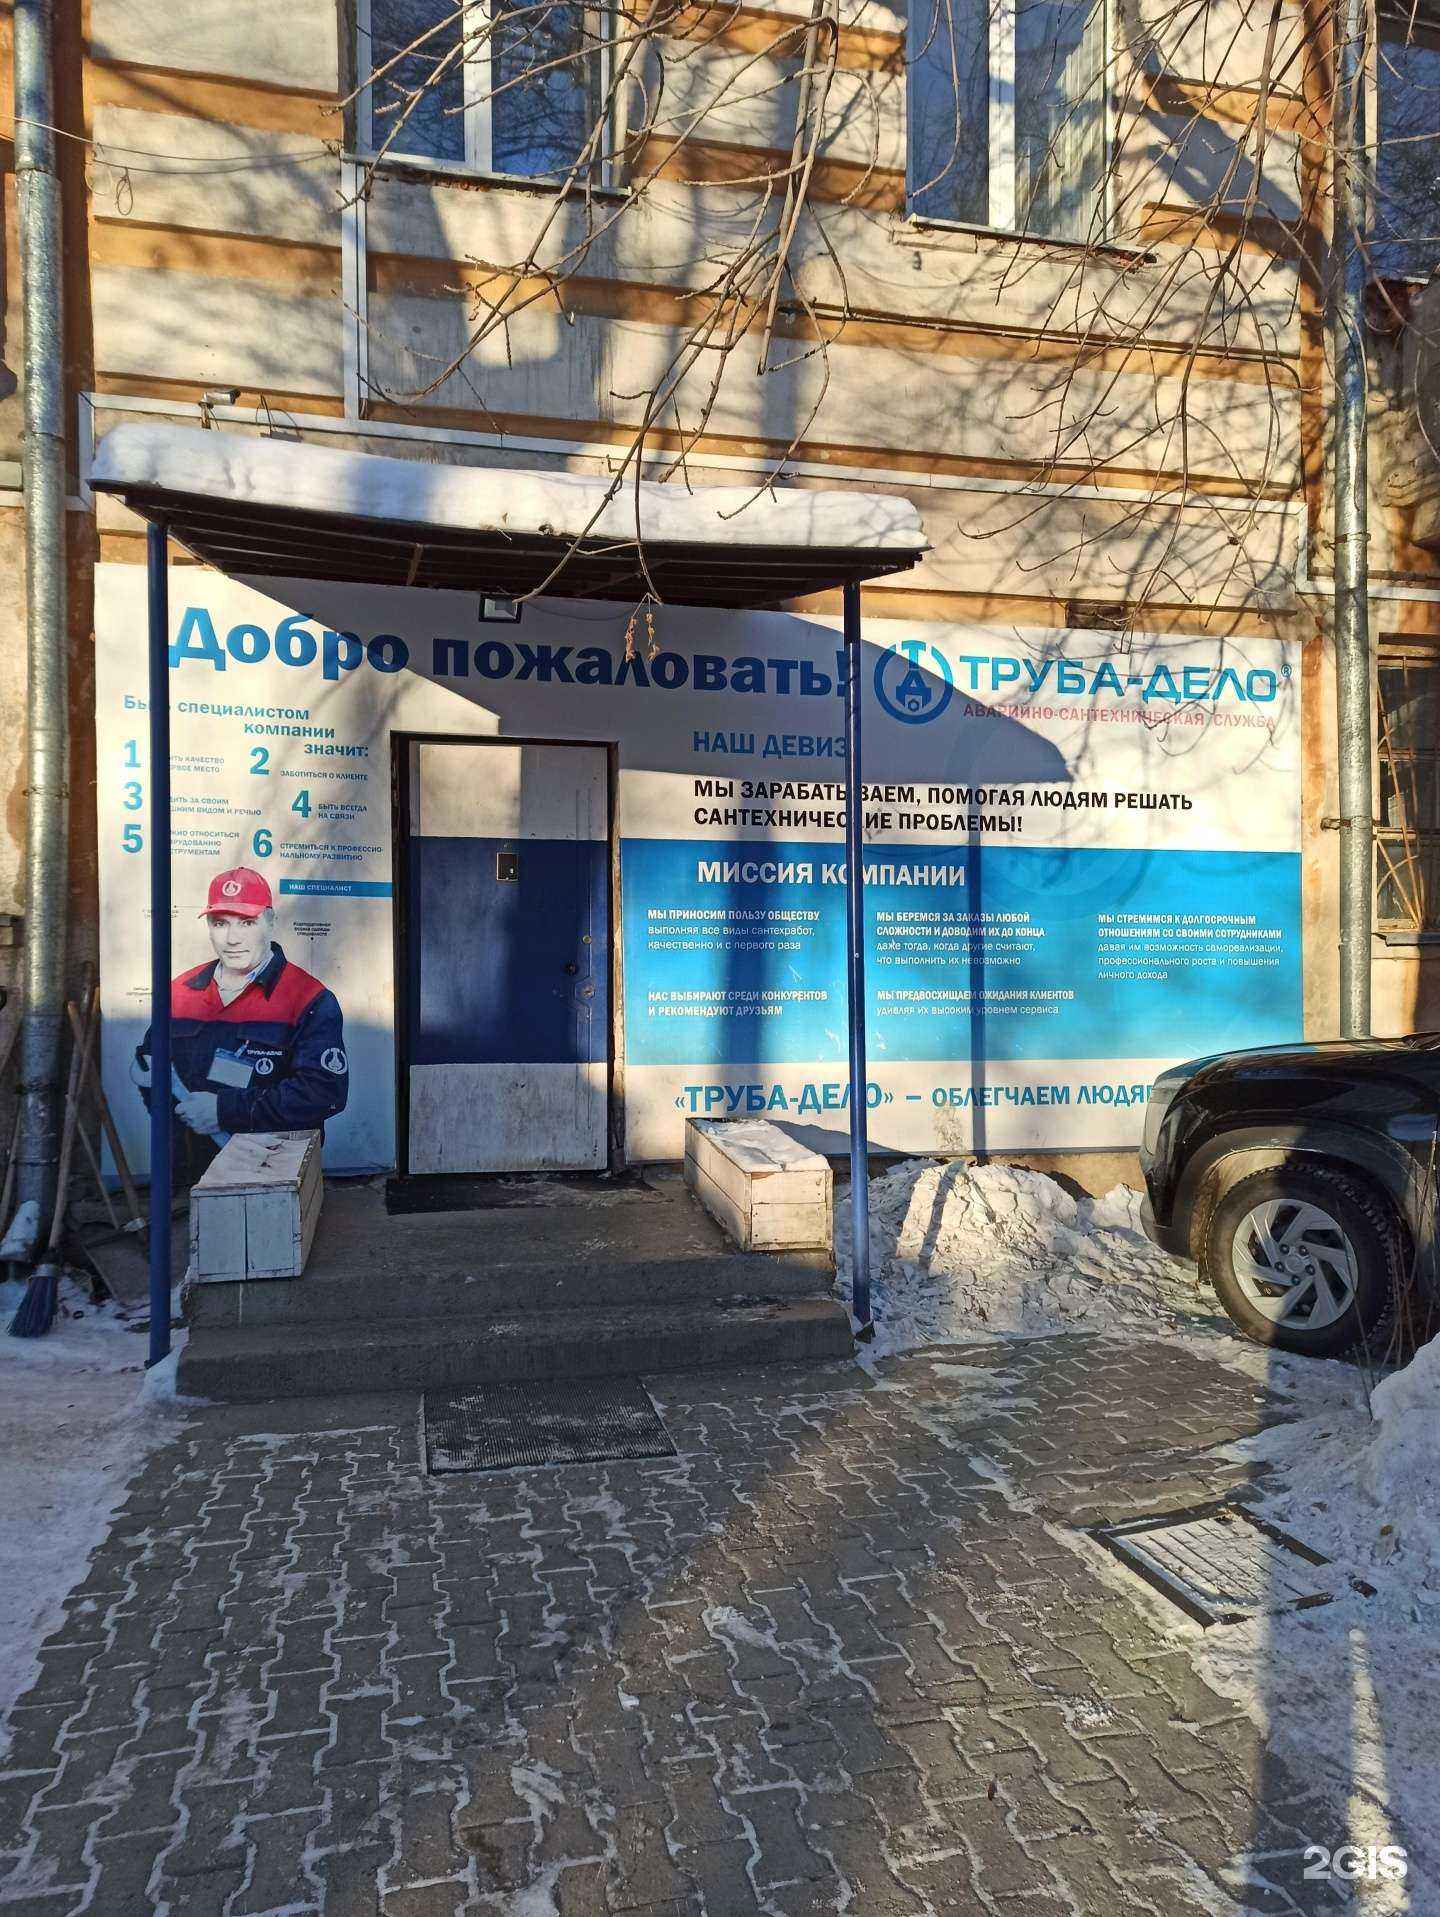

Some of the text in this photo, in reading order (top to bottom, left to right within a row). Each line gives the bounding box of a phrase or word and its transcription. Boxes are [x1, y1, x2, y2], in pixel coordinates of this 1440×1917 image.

[168, 607, 849, 697] Добро пожаловать!
[123, 694, 309, 720] Бы специалистом
[963, 703, 1275, 728] АВАРИЙНО-САНТЕХНИЧЕСКАЯ СЛУЖБА
[244, 723, 335, 739] компании
[304, 743, 369, 757] значит:
[693, 731, 847, 759] НАШ ДЕВИЗ
[123, 739, 141, 768] 1
[184, 756, 225, 764] КАЧЕСТВО
[249, 746, 270, 775] 2
[193, 765, 220, 773] МЕСТО
[280, 770, 328, 779] ЗАБОТИТЬСЯ
[335, 773, 368, 781] КЛИЕНТЕ
[123, 781, 143, 810] 3
[694, 780, 734, 798] МЫ
[928, 787, 1025, 806] ПОМОГАЯ
[1030, 790, 1108, 810] ЛЮДЯМ
[1114, 792, 1193, 810] РЕШАТЬ
[201, 797, 229, 805] СВОИМ
[291, 790, 312, 818] 4
[196, 806, 225, 815] ВИДОМ
[318, 803, 368, 812] БЫТЬ ВСЕГДА
[694, 807, 1023, 832] САНТЕХНИЧЕСИЕ ПРОБЛЕМЫ!
[121, 823, 143, 853] 5
[189, 830, 240, 838] ОТНОСИТЬСЯ
[252, 828, 273, 858] 6
[280, 842, 329, 851] СТРЕМИТЬСЯ
[280, 852, 363, 861] НАЛЬНОМУ РАЗВИТИЮ
[697, 861, 813, 884] МИССИЯ
[306, 884, 352, 892] СПЕЦИАЛИСТ
[648, 910, 819, 922] МЫ ПРИНОСИМ ПОЛЬЗУ ОБЩЕСТВУ
[876, 912, 1030, 923] МЫ БЕРЕМСЯ ЗА ЗАКАЗЫ ЛЮБОЙ
[1098, 914, 1256, 925] МЫ СТРЕМИМСЯ К ДОЛГОСРОЧНЫМ
[648, 926, 815, 937] выполняя все виды сантехработ,
[876, 926, 1045, 938] СЛОЖНОСТИ И ДОВОДИМ ИХ ДО КОНЦА
[1098, 928, 1282, 939] ОТНОШЕНИЯМ СО СВОИМИ СОТРУДНИКАМИ
[648, 940, 801, 950] качественно и с первого раза
[876, 942, 901, 951] даже
[933, 942, 959, 952] когда
[961, 943, 993, 952] другие
[995, 943, 1036, 952] считают,
[1098, 943, 1126, 952] давая
[1128, 943, 1141, 952] им
[1143, 943, 1203, 952] возможность
[876, 957, 1021, 966] что выполнить их невозможно
[1098, 957, 1190, 966] профессионального
[1227, 958, 1280, 966] повышения
[1098, 971, 1168, 980] личного дохода
[648, 990, 827, 1001] НАС ВЫБИРАЮТ СРЕДИ КОНКУРЕНТОВ
[877, 990, 1074, 1001] МЫ ПРЕДВОСХИЩАЕМ ОЖИДАНИЯ КЛИЕНТОВ
[648, 1005, 783, 1016] И РЕКОМЕНДУЮТ ДРУЗЬЯМ
[917, 1006, 929, 1014] их
[976, 1005, 1018, 1015] уровнем
[1020, 1005, 1059, 1015] сервиса
[932, 1086, 1070, 1107] ОБЛЕГЧАЕМ
[1076, 1084, 1153, 1107] ЛЮДЯ
